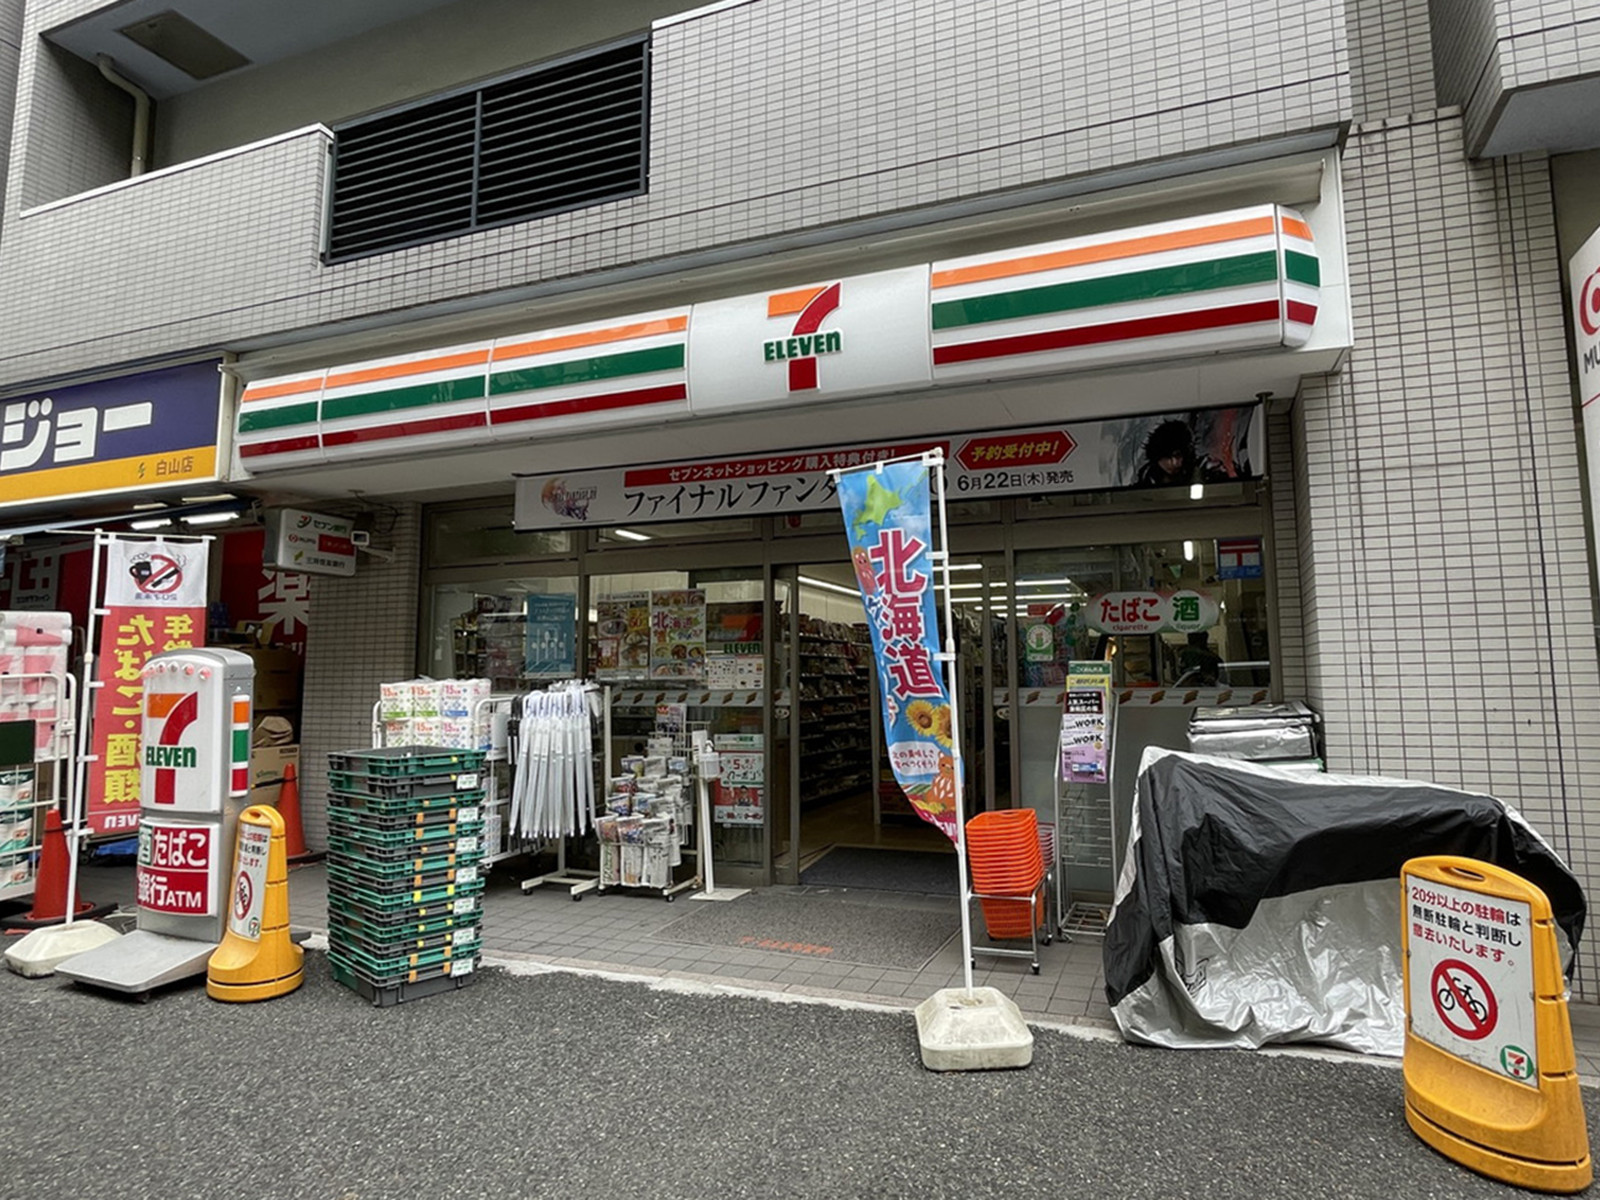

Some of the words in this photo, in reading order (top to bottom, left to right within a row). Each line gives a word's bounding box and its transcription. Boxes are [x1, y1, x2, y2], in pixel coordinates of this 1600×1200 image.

[0, 398, 153, 471] ジョー
[970, 439, 1060, 462] 予約受付中!
[155, 456, 194, 476] 白山店
[957, 470, 1074, 491] 6月22日(木)発売
[869, 529, 942, 699] 北海道
[1101, 597, 1160, 622] たばこ
[1173, 597, 1199, 621] 酒
[153, 829, 207, 867] たばこ
[1412, 886, 1521, 927] 20分以上の駐輪は
[1413, 904, 1522, 947] 無断駐輪と判断し
